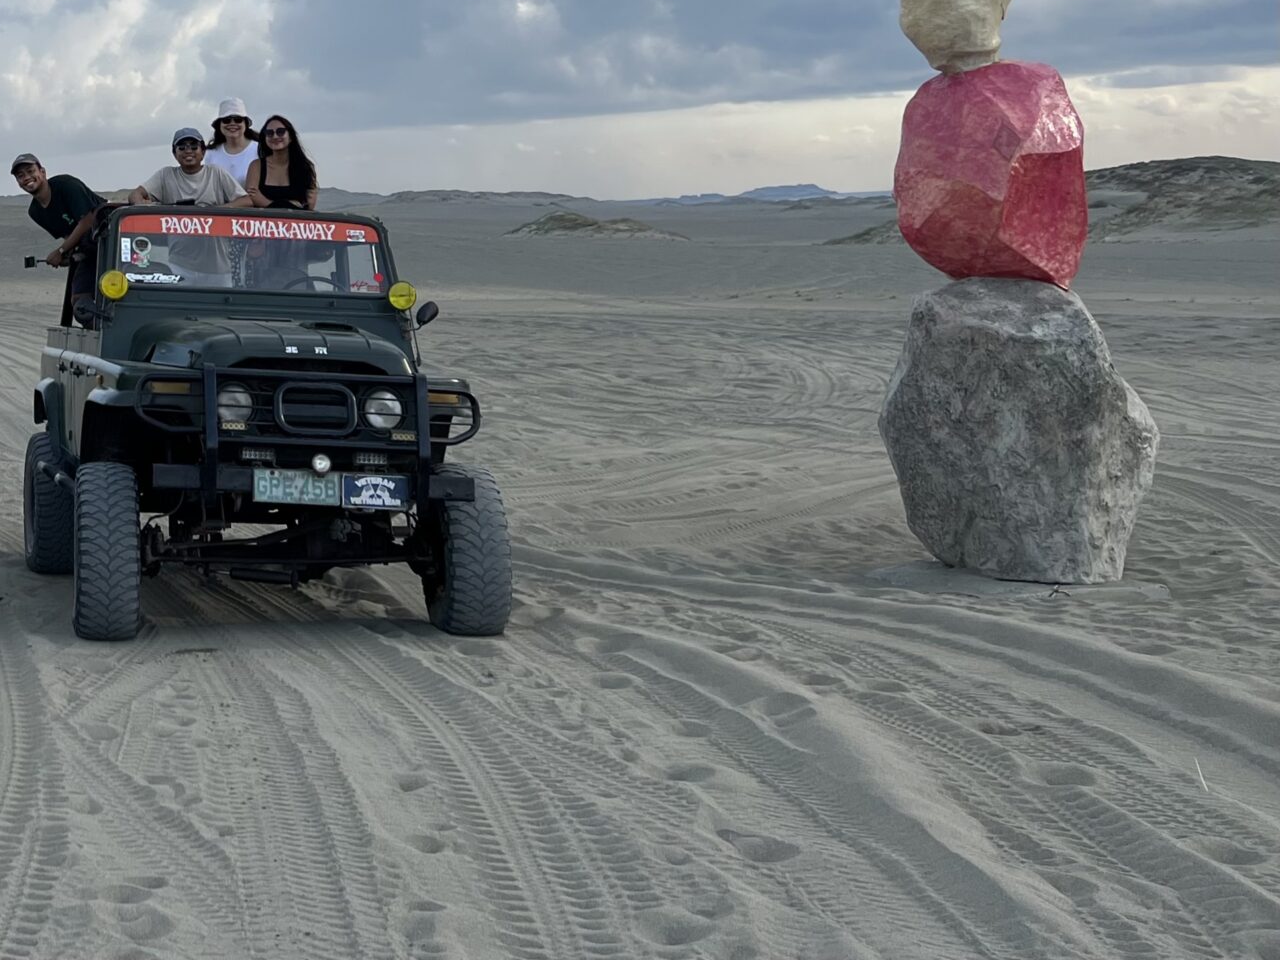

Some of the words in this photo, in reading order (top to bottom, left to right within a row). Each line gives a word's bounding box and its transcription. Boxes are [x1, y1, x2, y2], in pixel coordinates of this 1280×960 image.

[160, 217, 213, 235] PAOAY
[231, 218, 336, 241] KUMAKAWAY
[354, 477, 395, 490] VETERAN
[350, 496, 383, 506] VIETNAM
[384, 498, 401, 507] WAR
